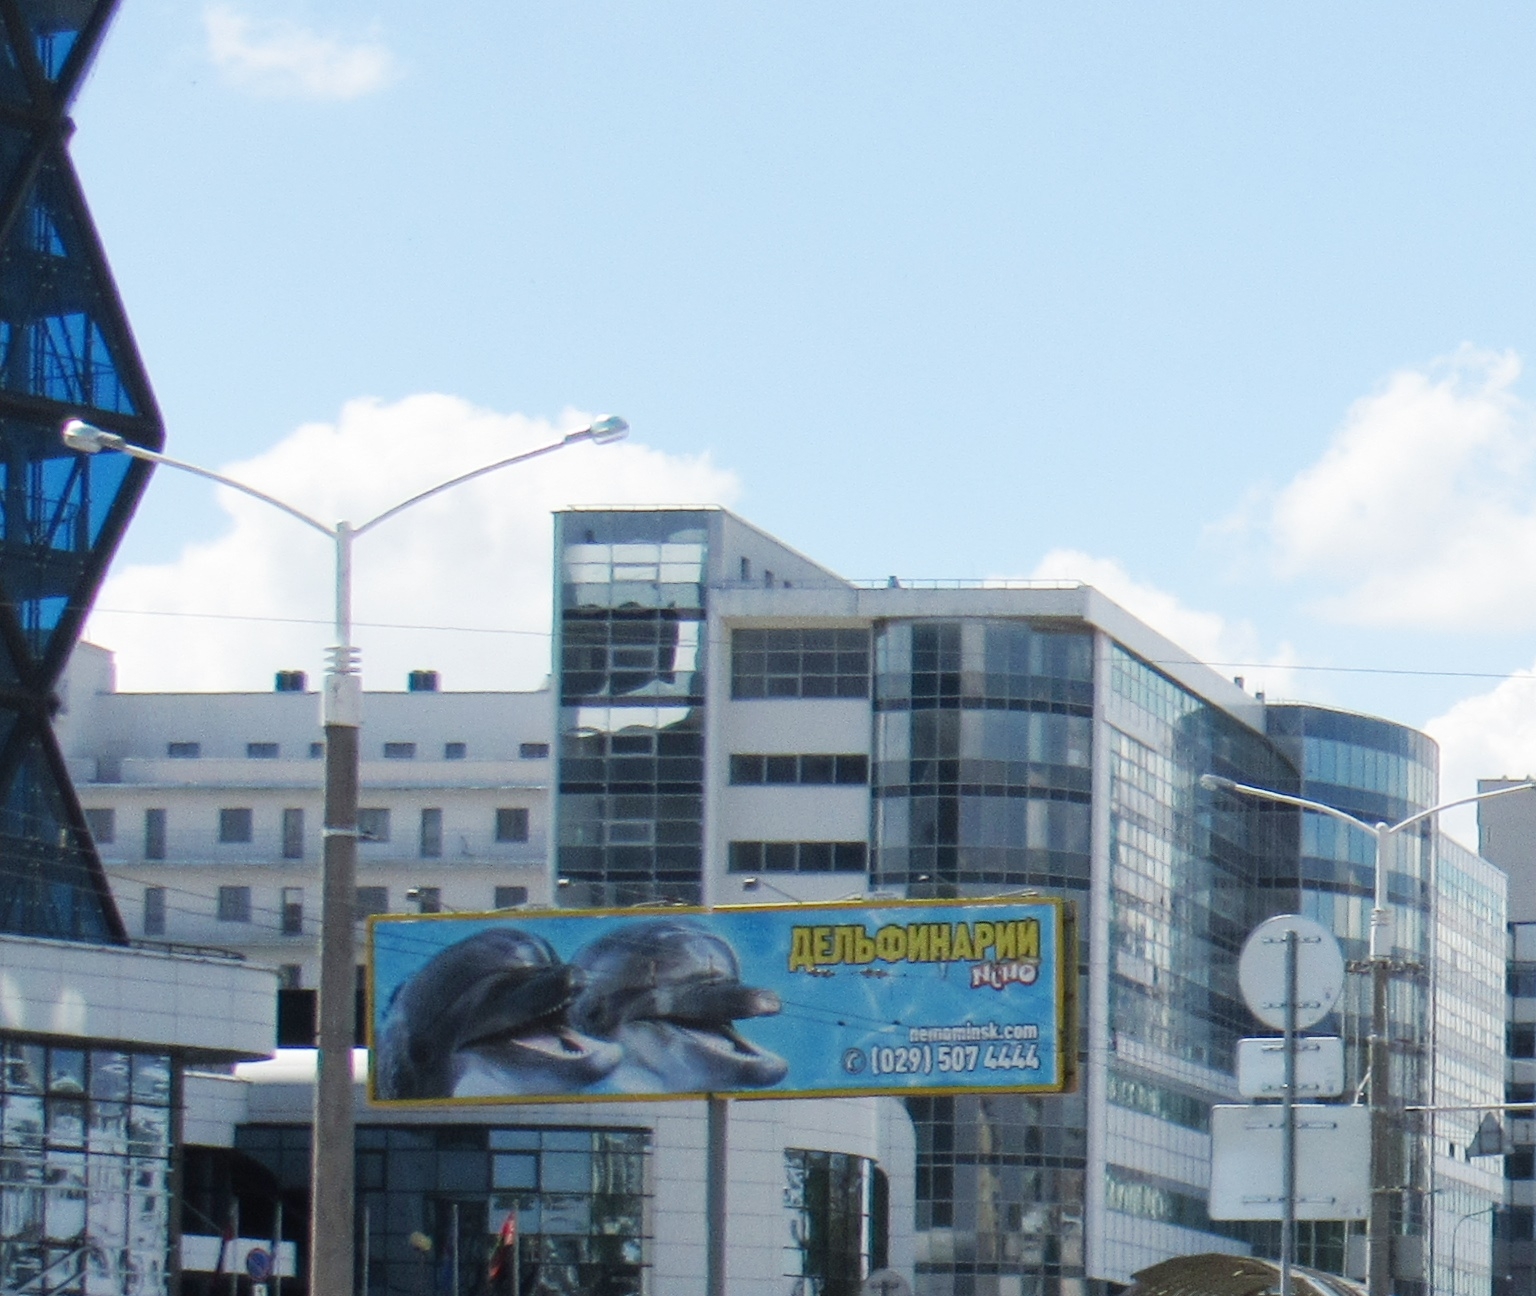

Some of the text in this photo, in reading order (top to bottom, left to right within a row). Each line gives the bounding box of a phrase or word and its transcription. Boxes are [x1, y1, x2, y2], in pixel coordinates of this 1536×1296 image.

[788, 917, 1042, 973] ДЕЛЬФИНАРИЙ
[870, 1043, 1040, 1074] (029) 507 4444
